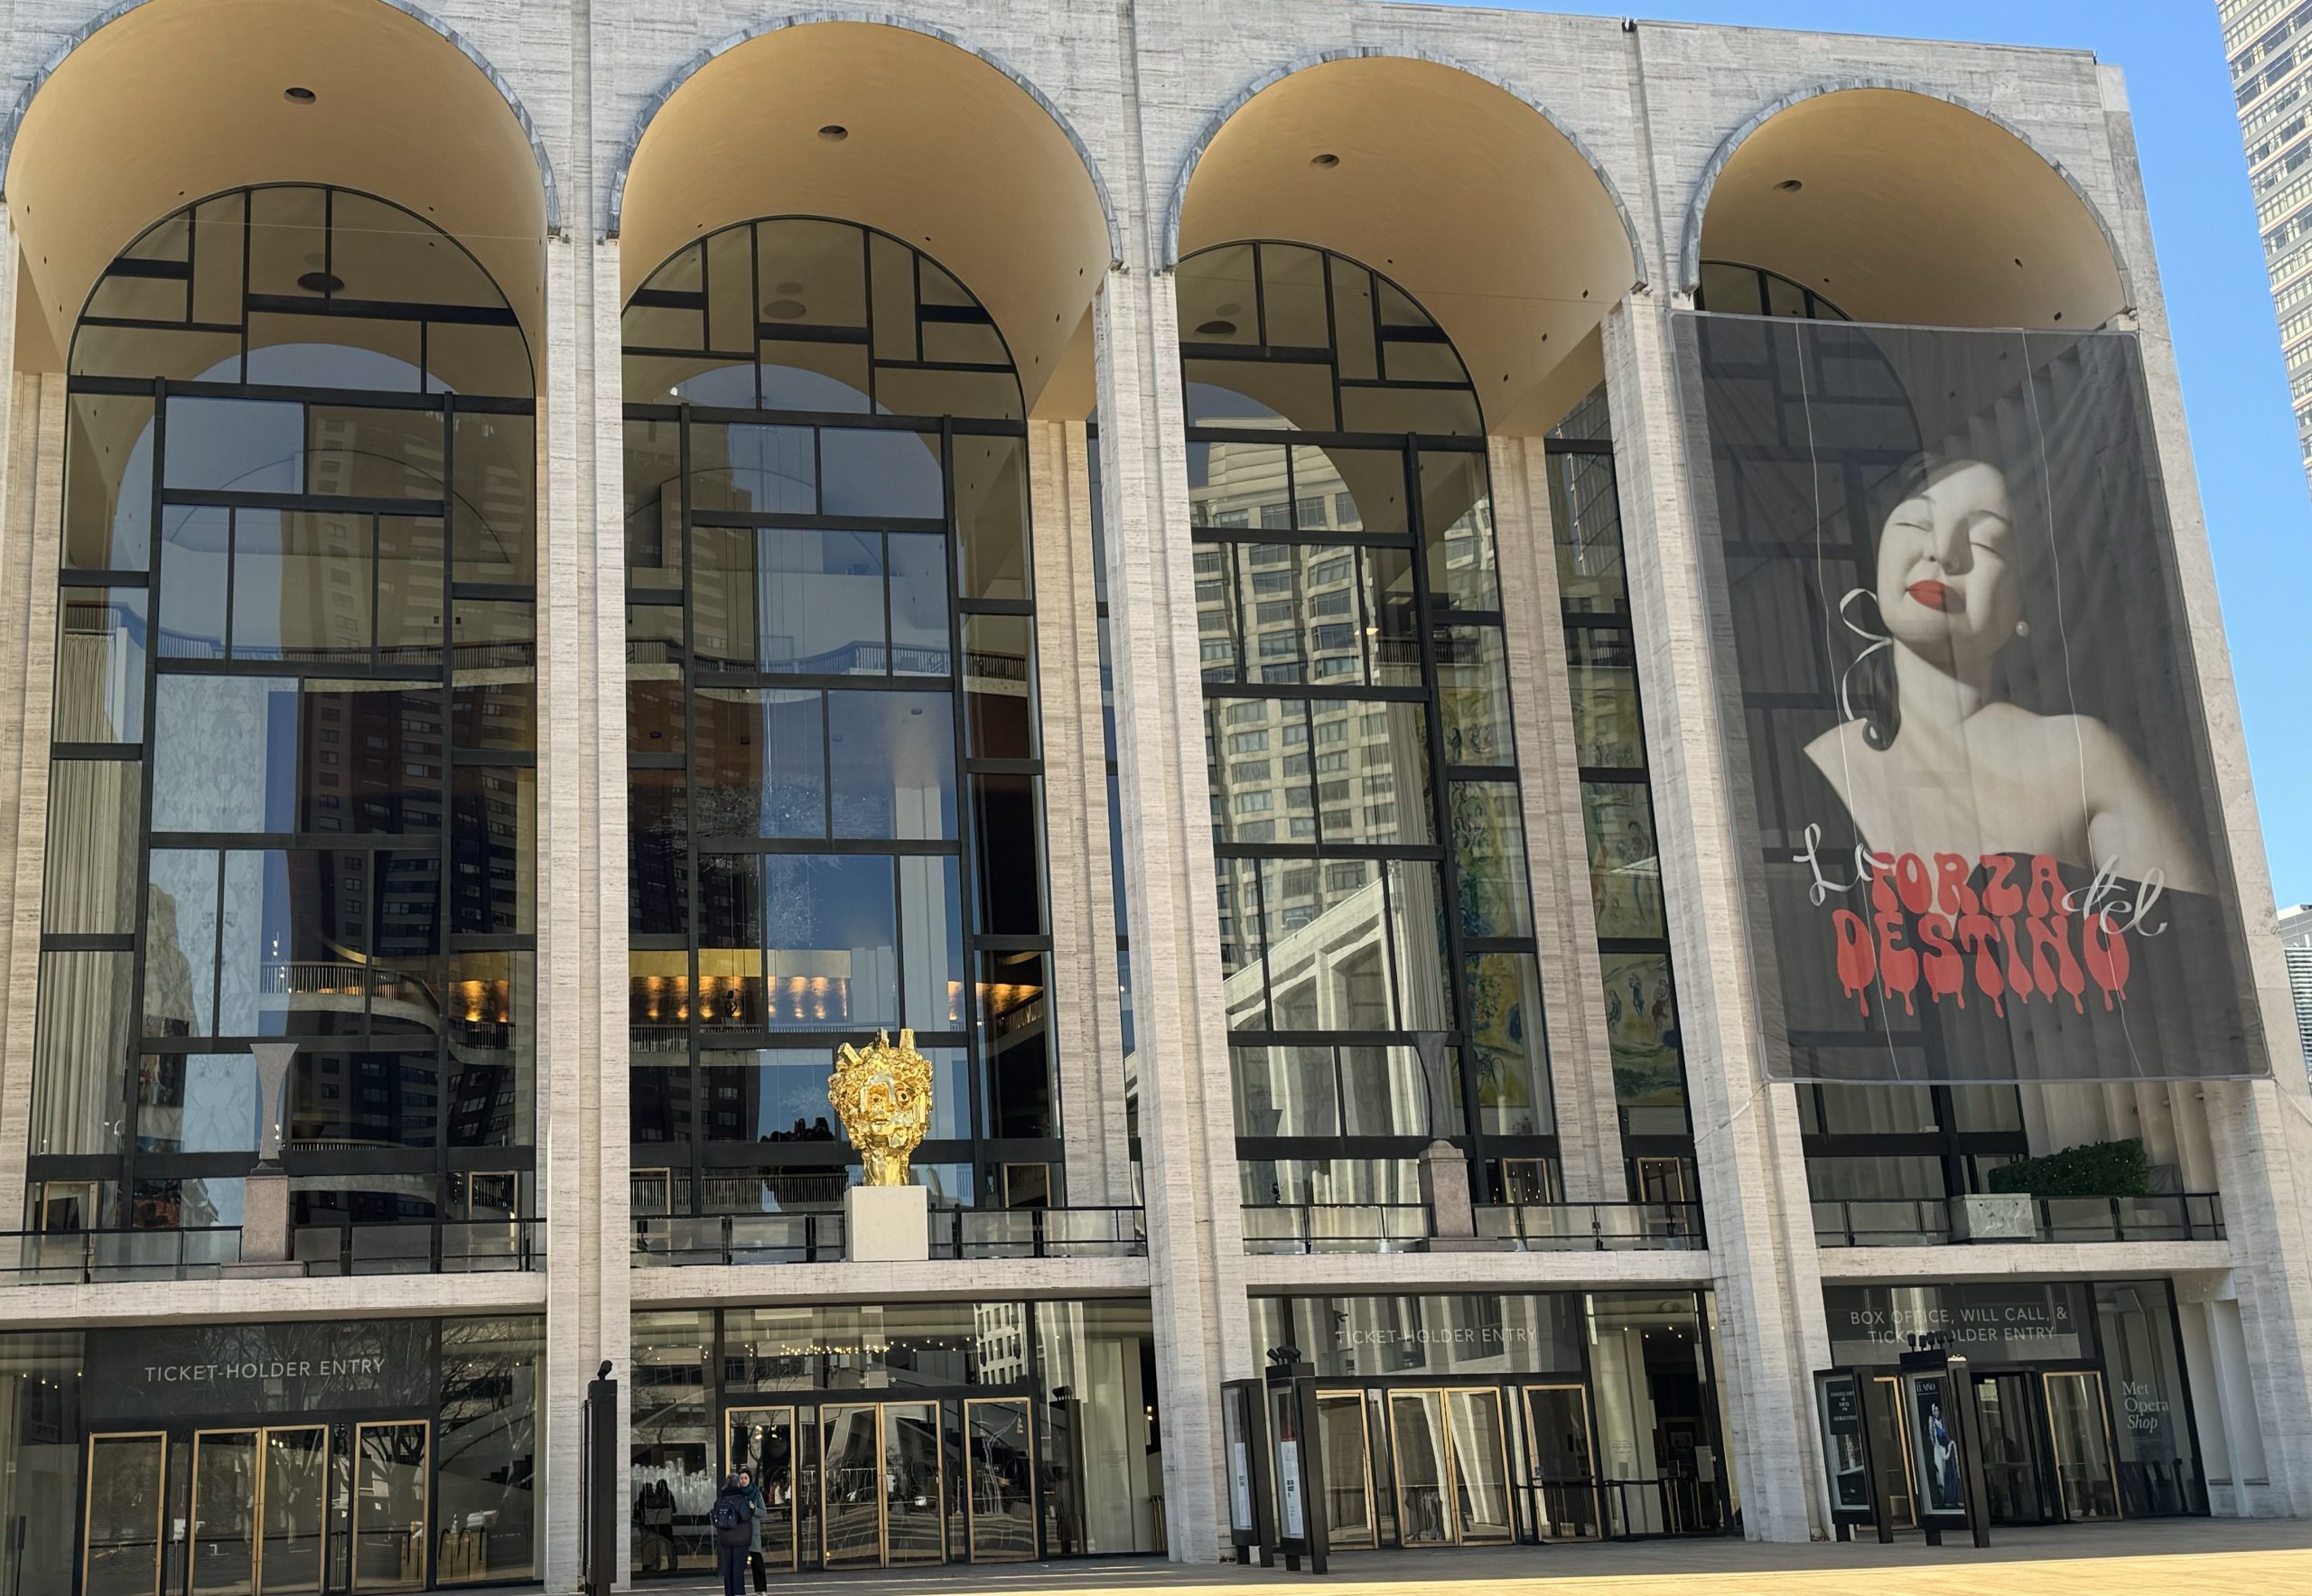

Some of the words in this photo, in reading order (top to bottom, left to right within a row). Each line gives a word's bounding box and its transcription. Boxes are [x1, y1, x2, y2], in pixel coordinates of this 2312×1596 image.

[1793, 823, 1893, 906] La
[1871, 852, 2074, 917] FORZA
[2061, 854, 2168, 937] del
[1832, 909, 2130, 1018] DESTINO
[1851, 1311, 1885, 1325] BOX
[1960, 1308, 2000, 1322] WILL
[2004, 1308, 2051, 1322] CALL,
[2056, 1306, 2068, 1320] &
[1335, 1329, 1474, 1345] TICKET-HOLDER
[1482, 1328, 1537, 1343] ENTRY
[2004, 1326, 2055, 1341] ENTRY
[144, 1361, 311, 1382] TICKET-HOLDER
[320, 1358, 386, 1376] ENTRY
[2122, 1380, 2149, 1395] Met
[2124, 1396, 2169, 1416] Opera
[2127, 1414, 2158, 1433] Shop
